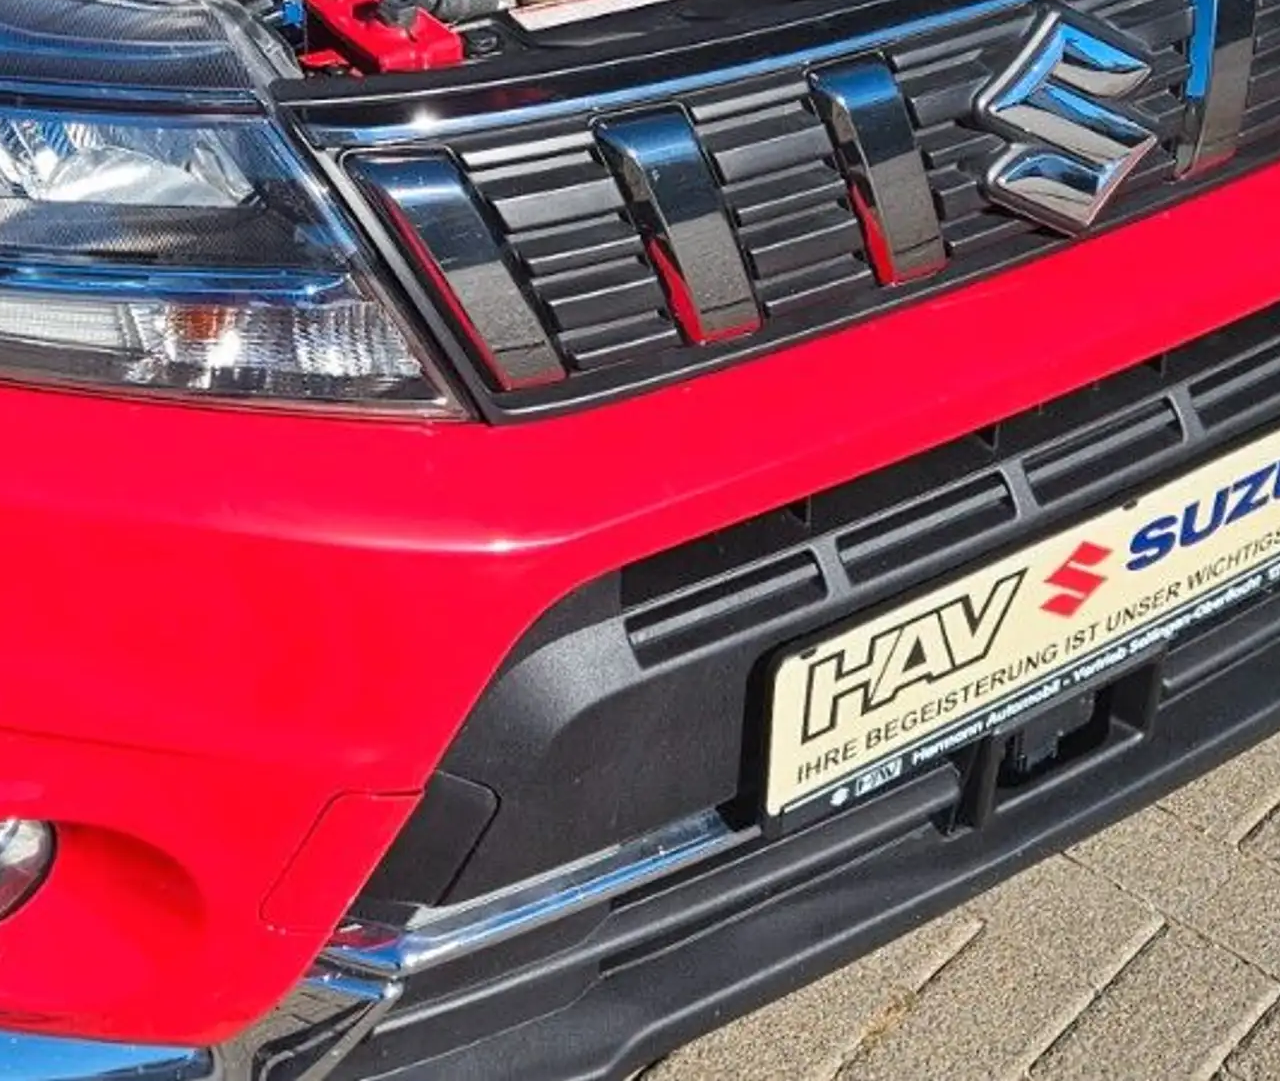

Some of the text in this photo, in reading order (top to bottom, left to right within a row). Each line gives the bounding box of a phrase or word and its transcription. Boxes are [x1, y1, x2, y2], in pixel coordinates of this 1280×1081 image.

[796, 736, 858, 784] IHRE
[865, 643, 1059, 750] BEGEISTERUNG
[1064, 622, 1101, 654] IST
[1105, 581, 1182, 632] UNSER
[800, 567, 1028, 745] HAV
